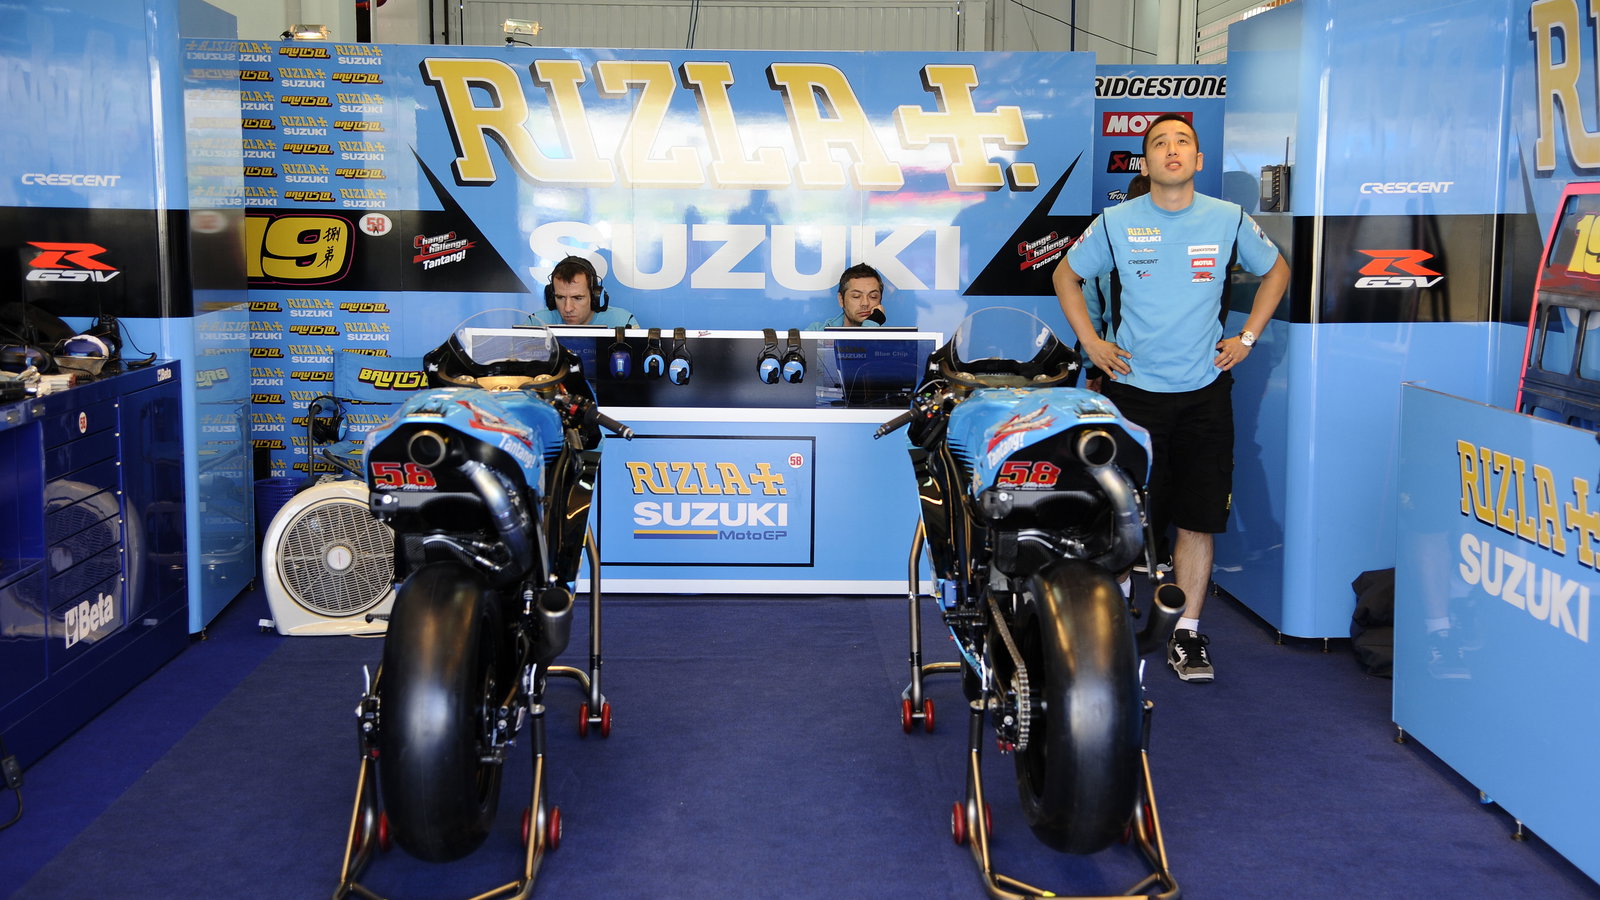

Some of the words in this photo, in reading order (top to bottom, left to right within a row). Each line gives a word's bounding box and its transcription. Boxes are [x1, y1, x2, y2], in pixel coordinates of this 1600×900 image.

[338, 57, 382, 66] SUZUKI
[281, 80, 325, 88] SUZUKI
[1095, 77, 1226, 97] RIDGESTONE
[340, 105, 384, 114] SUZUKI
[283, 128, 327, 136] SUZUKI
[341, 153, 385, 161] SUZUKI
[22, 173, 120, 187] CRESCENT
[285, 176, 328, 184] SUZUKI
[1360, 181, 1454, 194] CRESCENT
[342, 200, 386, 208] SUZUKI
[366, 217, 386, 233] 58
[421, 239, 468, 256] Challenge
[1026, 237, 1070, 261] Challenge
[529, 221, 960, 291] SUZUKI
[290, 310, 332, 318] SUZUKI
[346, 333, 390, 342] SUZUKI
[288, 344, 334, 356] RIZLA+
[892, 350, 909, 358] Chip
[292, 356, 334, 364] SUZUKI
[499, 432, 537, 468] Tantang!
[789, 456, 803, 466] 58
[370, 462, 438, 488] 58
[997, 460, 1062, 486] 58
[633, 501, 788, 527] SUZUKI
[719, 530, 788, 541] MotoGP
[1459, 533, 1590, 643] SUZUKI
[78, 591, 114, 639] Beta
